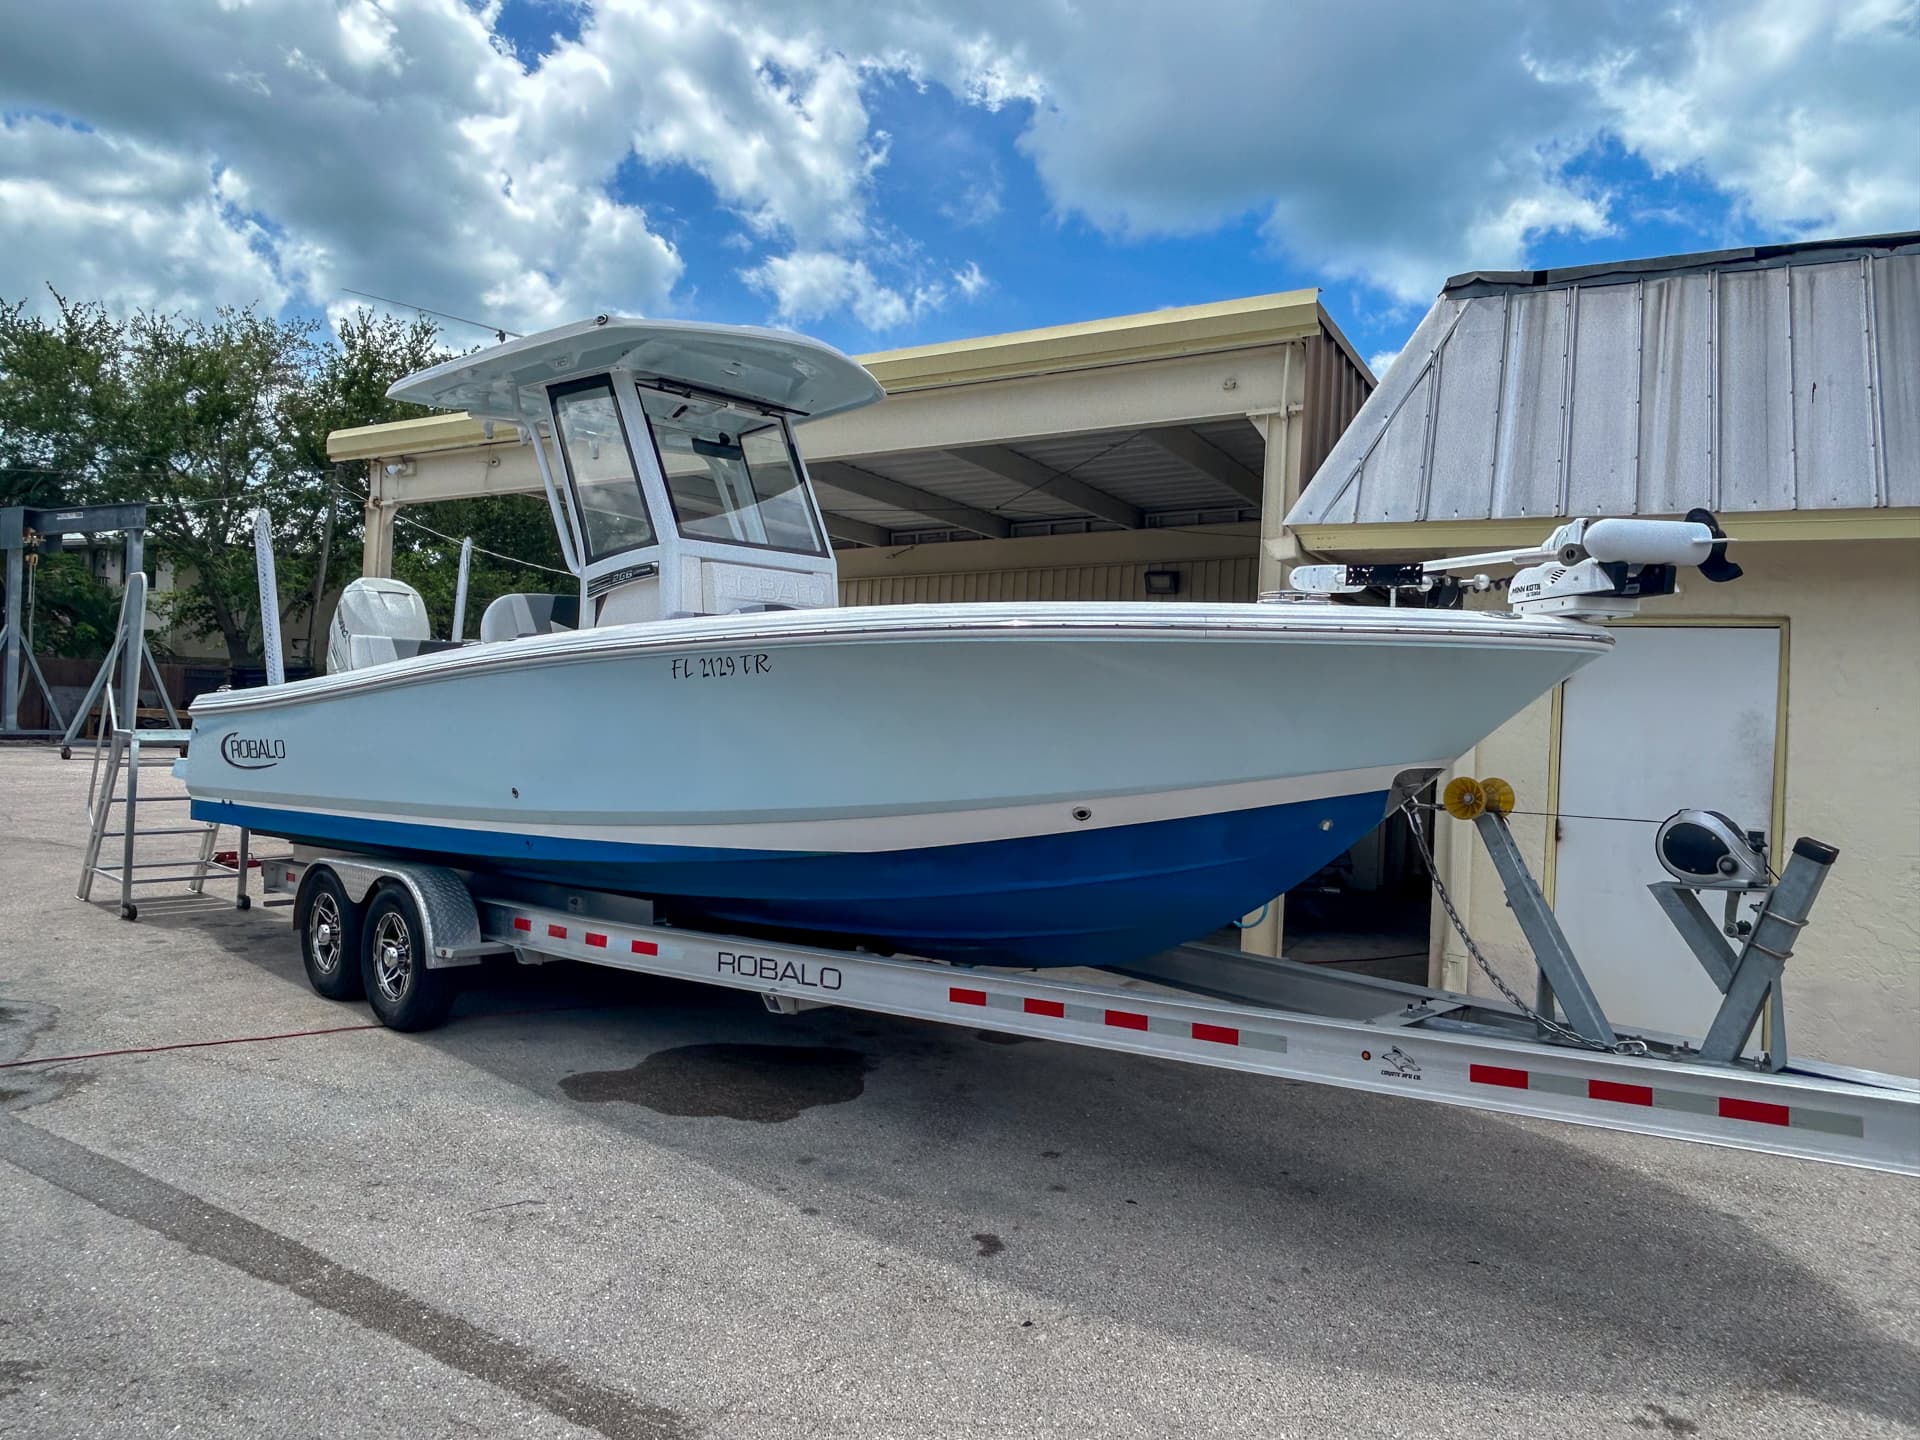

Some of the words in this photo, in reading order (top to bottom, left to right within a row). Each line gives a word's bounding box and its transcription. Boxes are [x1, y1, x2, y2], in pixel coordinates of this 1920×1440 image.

[672, 658, 694, 679] FL
[699, 656, 735, 678] 2129
[740, 653, 772, 675] TR
[230, 738, 286, 759] ROBALO
[718, 951, 842, 991] ROBALO
